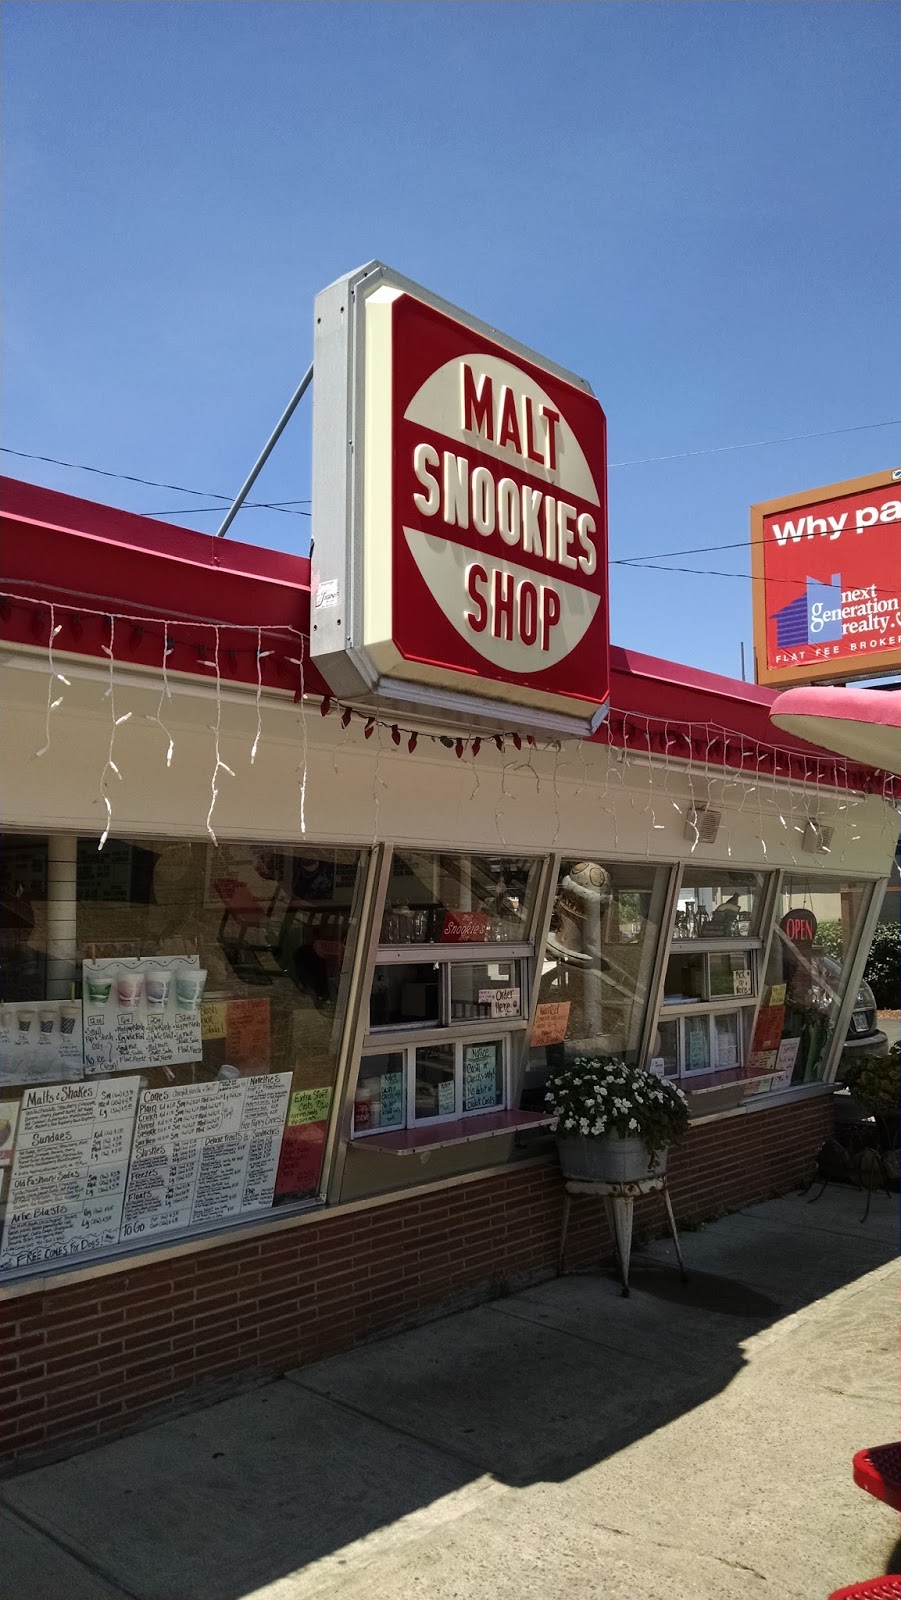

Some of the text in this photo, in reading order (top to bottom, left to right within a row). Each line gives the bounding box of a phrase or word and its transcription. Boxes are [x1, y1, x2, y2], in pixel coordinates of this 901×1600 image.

[460, 362, 560, 472] MALT
[413, 443, 597, 575] SNOOKIES
[771, 513, 848, 547] Why
[841, 583, 877, 603] next
[464, 562, 561, 651] SHOP
[810, 598, 899, 632] generation
[775, 651, 805, 663] FLAT
[816, 646, 840, 656] FEE
[444, 921, 486, 935] Snookie's
[786, 919, 813, 940] OPEN
[496, 990, 514, 1001] Order
[26, 1089, 54, 1107] Malts
[143, 1091, 169, 1103] Cones
[32, 1131, 72, 1146] Sundaes
[16, 1251, 41, 1267] FREE
